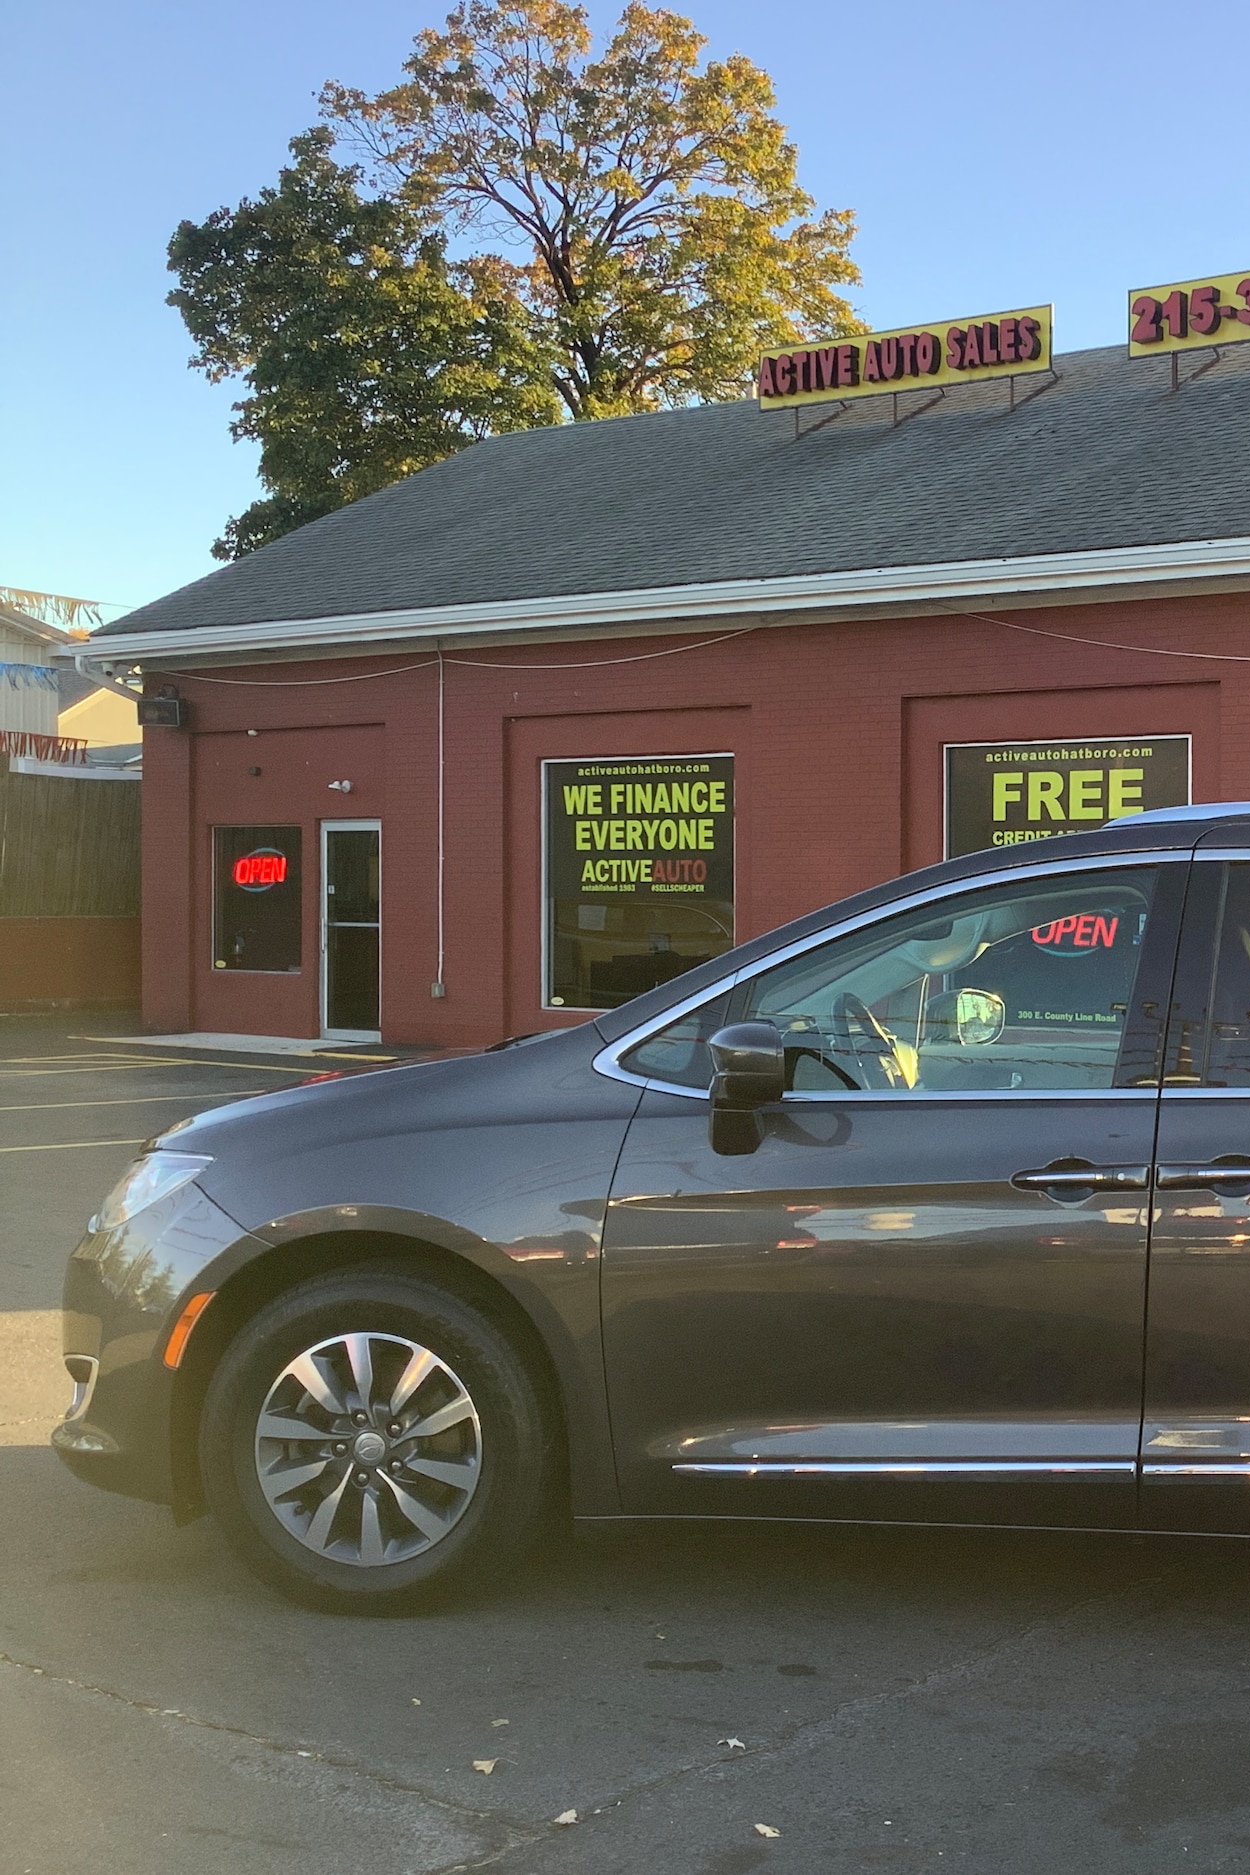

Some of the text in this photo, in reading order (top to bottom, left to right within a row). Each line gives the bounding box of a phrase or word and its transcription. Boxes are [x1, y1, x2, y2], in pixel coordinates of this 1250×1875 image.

[759, 316, 1040, 397] ACTIVE AUTO SALES
[577, 764, 710, 777] activeautohatboro.com
[985, 746, 1153, 763] activeautohatboro.com
[563, 781, 726, 815] WE FINANCE
[992, 768, 1144, 822] FREE
[575, 818, 715, 851] EVERYONE
[234, 856, 287, 884] OPEN
[1031, 914, 1119, 947] OPEN
[1017, 1010, 1117, 1023] 300 E. County Line Road
